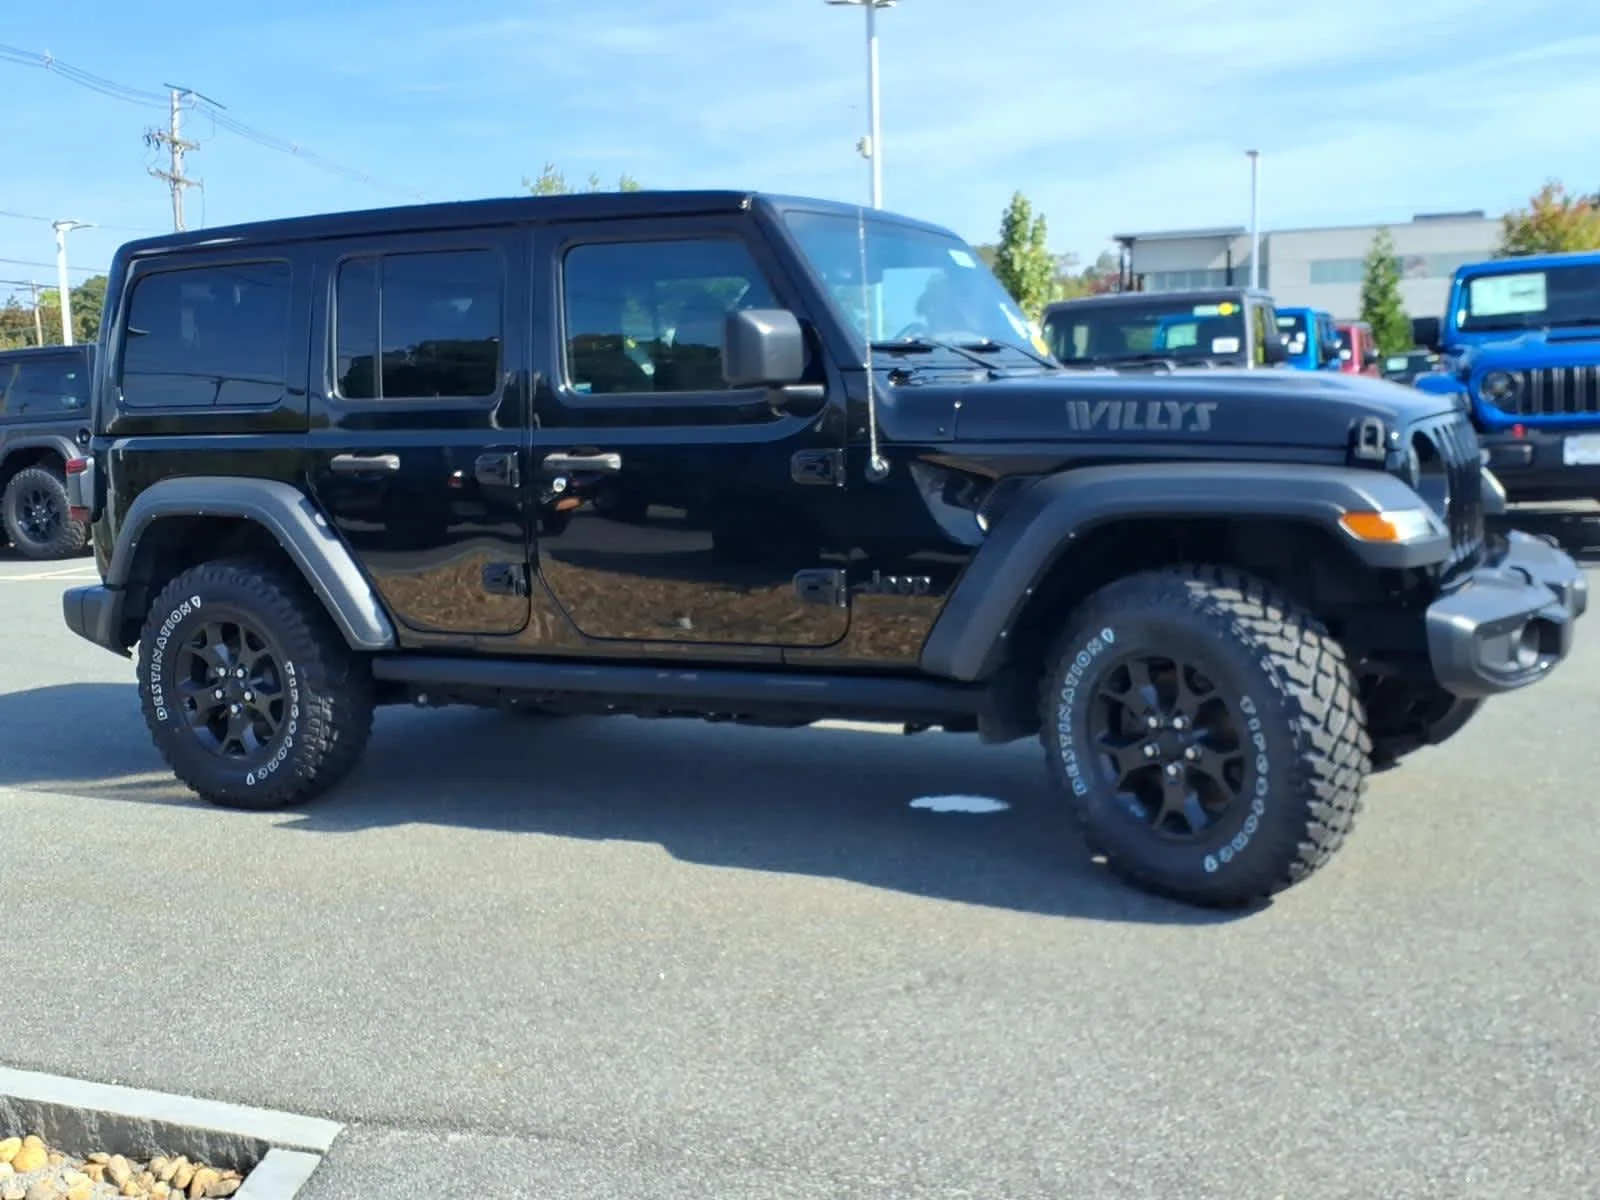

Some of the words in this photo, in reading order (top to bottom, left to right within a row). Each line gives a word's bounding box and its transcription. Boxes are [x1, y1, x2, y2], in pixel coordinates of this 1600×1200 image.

[1066, 400, 1217, 432] WILLYS
[151, 602, 192, 720] DESTINATION
[1059, 638, 1102, 796] DESTINATION
